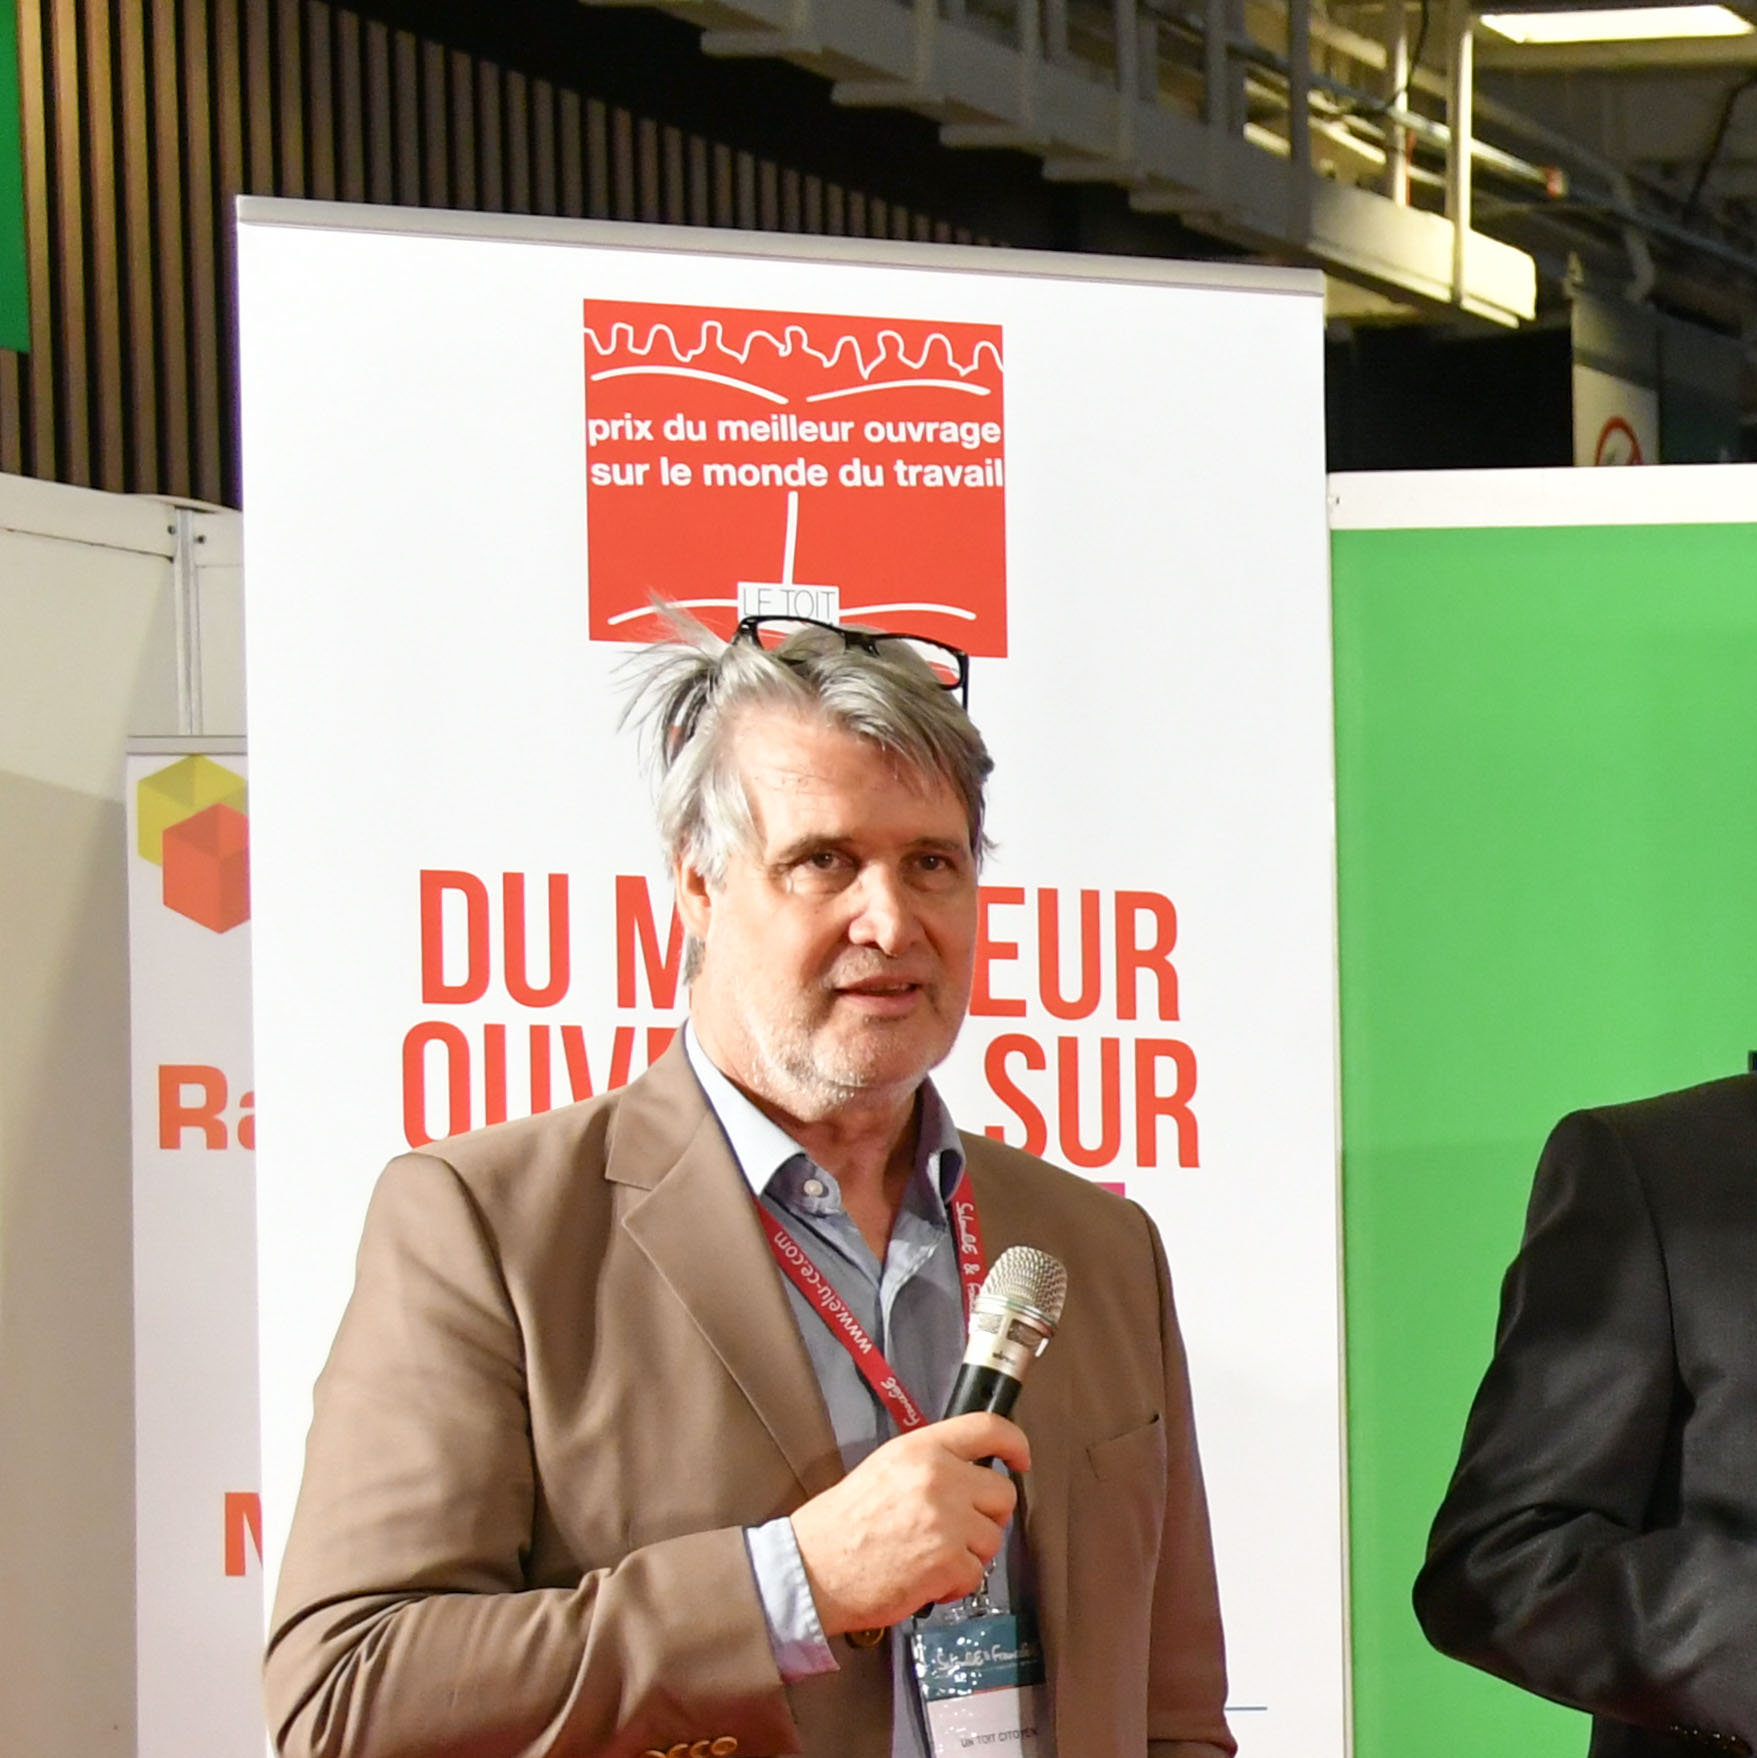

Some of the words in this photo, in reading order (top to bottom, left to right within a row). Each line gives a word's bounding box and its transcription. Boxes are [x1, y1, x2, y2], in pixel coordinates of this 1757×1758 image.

[587, 413, 653, 446] prix
[663, 414, 706, 441] du
[718, 414, 853, 442] meilleur
[864, 420, 1000, 449] ouvrage
[591, 461, 649, 486] sur
[660, 457, 691, 487] le
[703, 457, 828, 487] monde
[839, 458, 883, 487] du
[894, 458, 1004, 487] travail
[742, 588, 773, 616] LE
[781, 590, 837, 619] TOIT
[419, 868, 571, 1009] DU
[984, 1033, 1201, 1170] SUR
[773, 1230, 873, 1355] www.elu-ce.com
[999, 1727, 1039, 1742] CITOYEN
